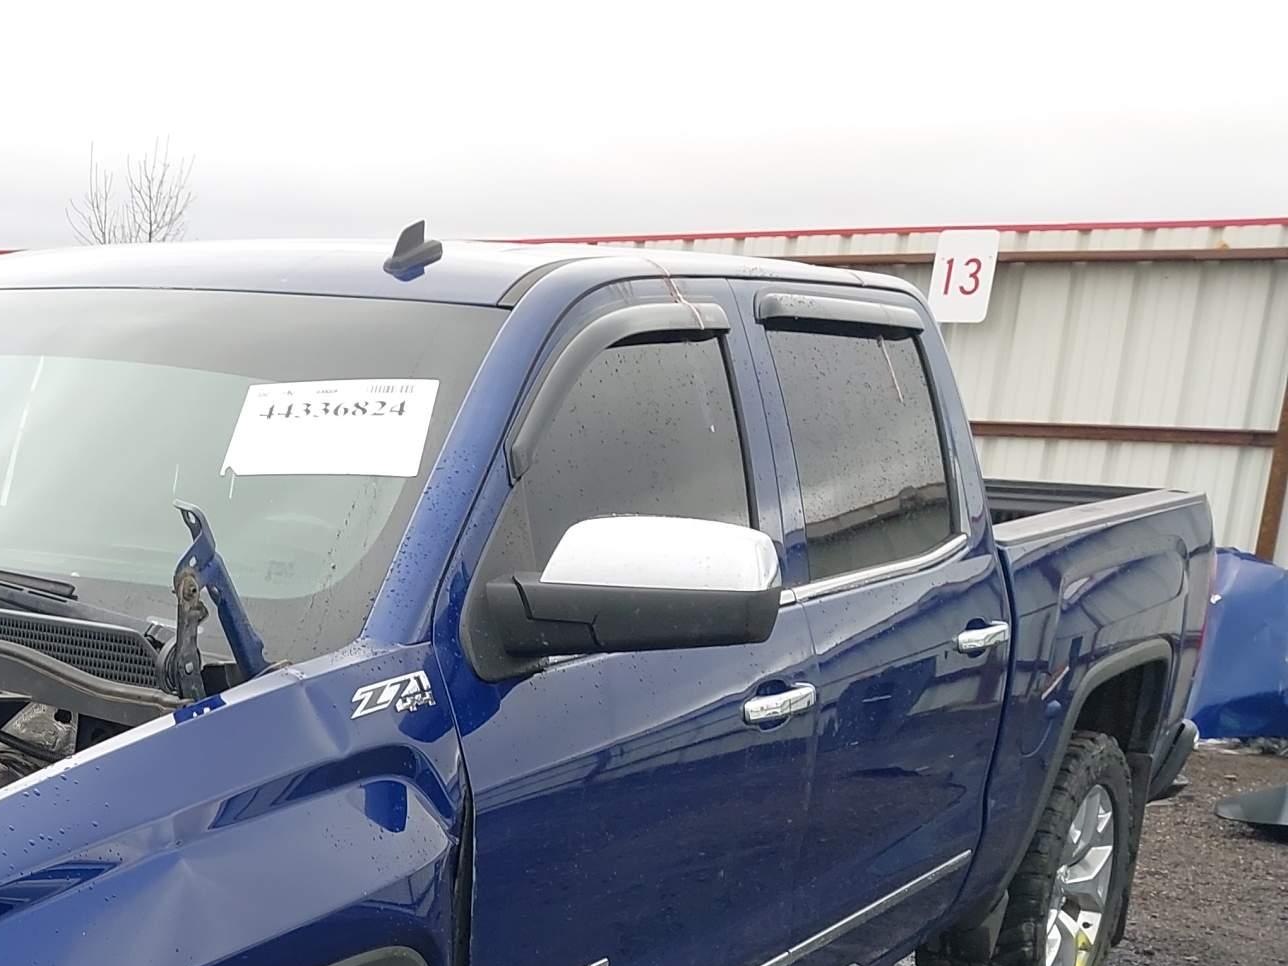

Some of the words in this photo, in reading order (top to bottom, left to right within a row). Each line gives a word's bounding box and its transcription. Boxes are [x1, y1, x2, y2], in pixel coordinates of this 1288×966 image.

[943, 257, 982, 296] 13
[259, 399, 406, 419] 44336824
[351, 670, 431, 720] Z71
